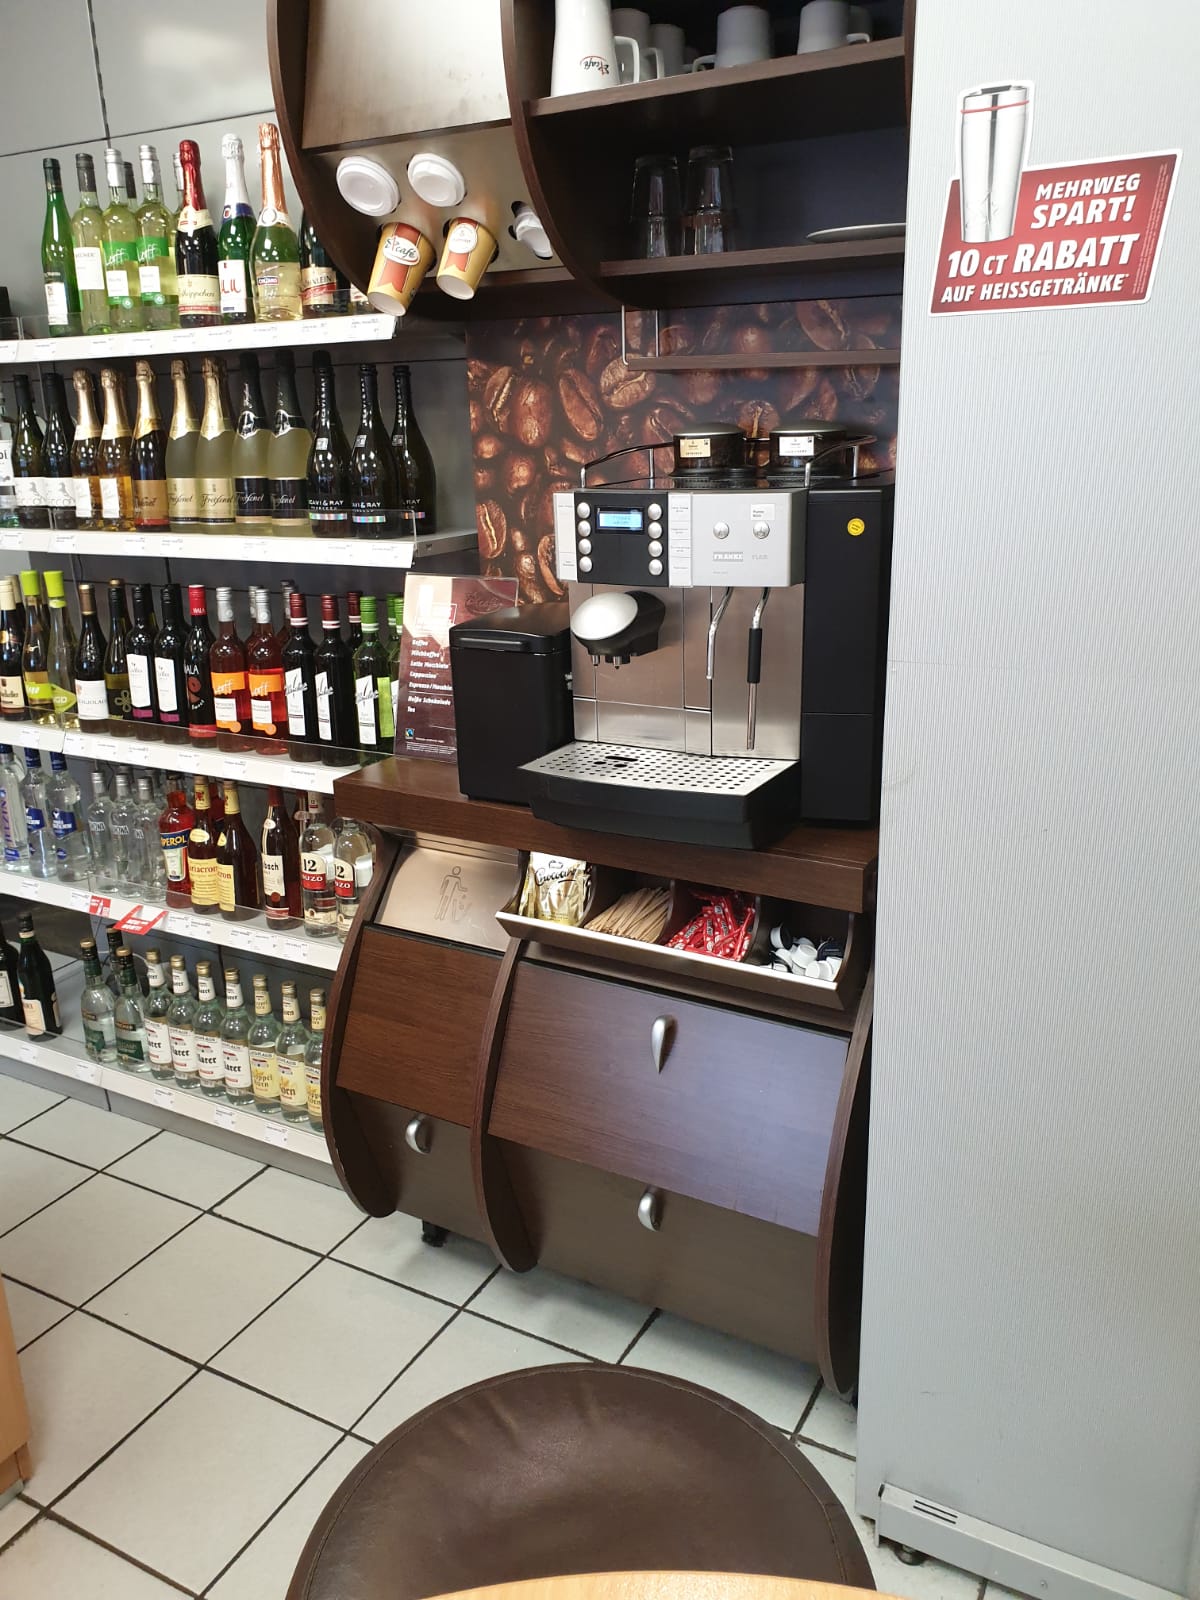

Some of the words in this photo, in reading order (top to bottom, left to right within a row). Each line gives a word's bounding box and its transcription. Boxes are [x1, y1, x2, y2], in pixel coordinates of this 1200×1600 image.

[1035, 173, 1141, 201] MEHRWEG
[1030, 195, 1136, 229] SPART!
[947, 249, 982, 278] 10
[983, 254, 1008, 276] CT
[1012, 233, 1140, 273] RABATT
[941, 285, 975, 303] AUF
[189, 864, 218, 874] ariacron
[303, 858, 317, 873] 12
[302, 873, 323, 882] UZO
